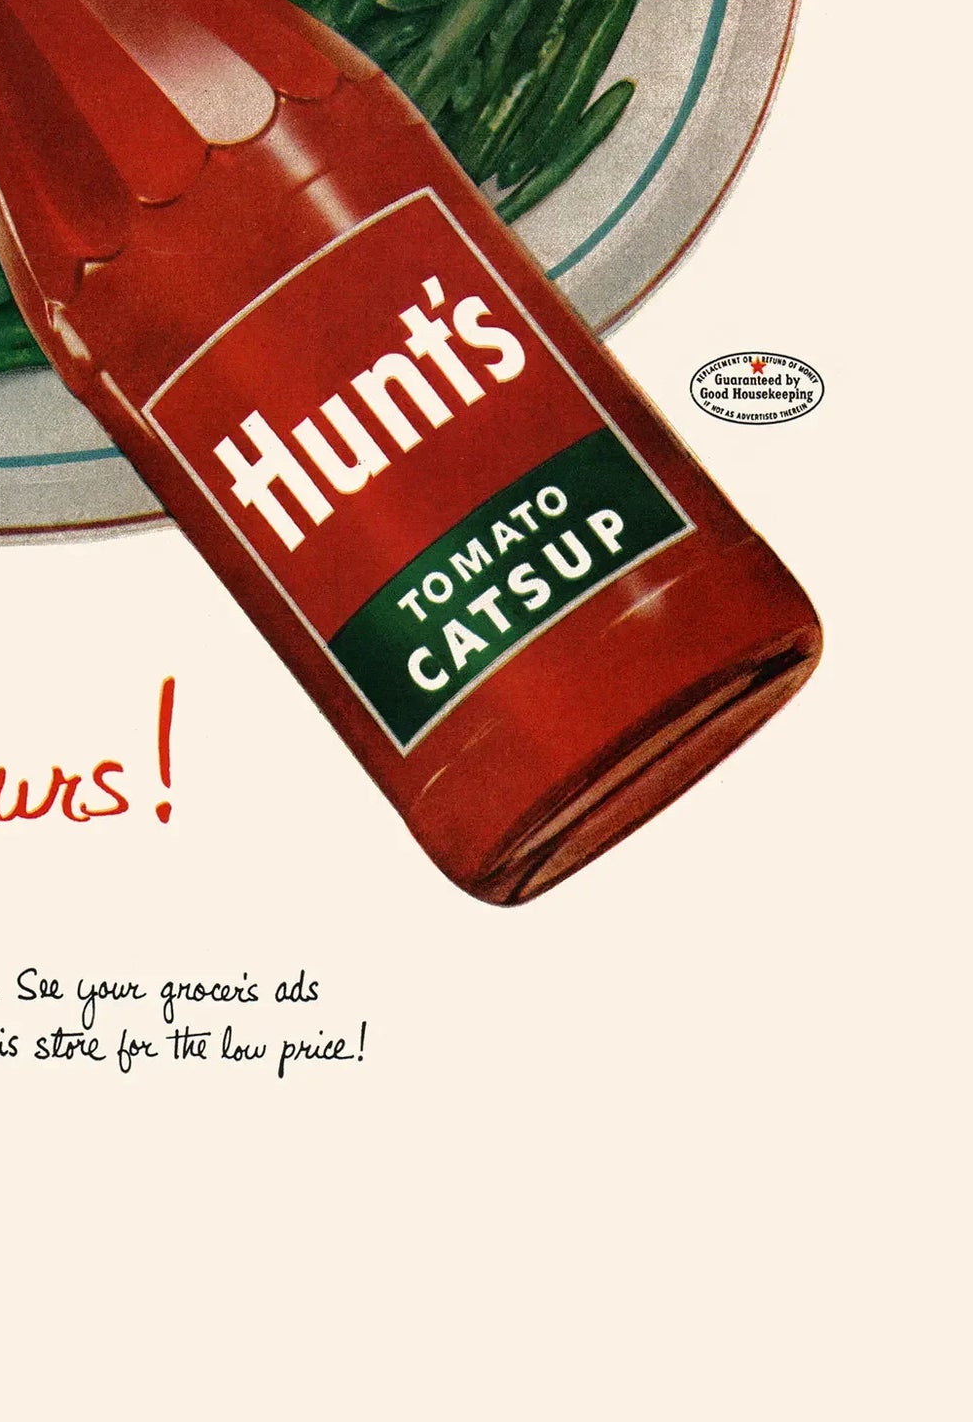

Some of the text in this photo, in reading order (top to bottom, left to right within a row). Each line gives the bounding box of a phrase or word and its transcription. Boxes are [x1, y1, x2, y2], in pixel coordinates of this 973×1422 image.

[696, 356, 740, 384] REPLACEMENT
[761, 356, 787, 367] REFUND
[788, 361, 798, 369] OF
[798, 366, 819, 385] MONEY
[699, 387, 814, 403] Good Housekeeping
[714, 373, 801, 389] Guaranteed by
[212, 275, 526, 553] Hunt's
[711, 404, 725, 415] NOT
[725, 410, 735, 418] AS
[736, 412, 778, 421] ADVERTISED
[779, 403, 808, 419] THEREIN
[397, 485, 568, 622] TOMATO
[406, 508, 625, 692] CATSUP
[17, 967, 64, 1000] See
[76, 978, 148, 1031] your
[160, 972, 259, 1024] grocer's
[274, 969, 319, 1003] ads
[34, 1026, 107, 1062] store
[116, 1028, 159, 1074] for
[165, 1025, 212, 1060] the
[220, 1025, 267, 1062] low
[277, 1020, 367, 1079] price!
